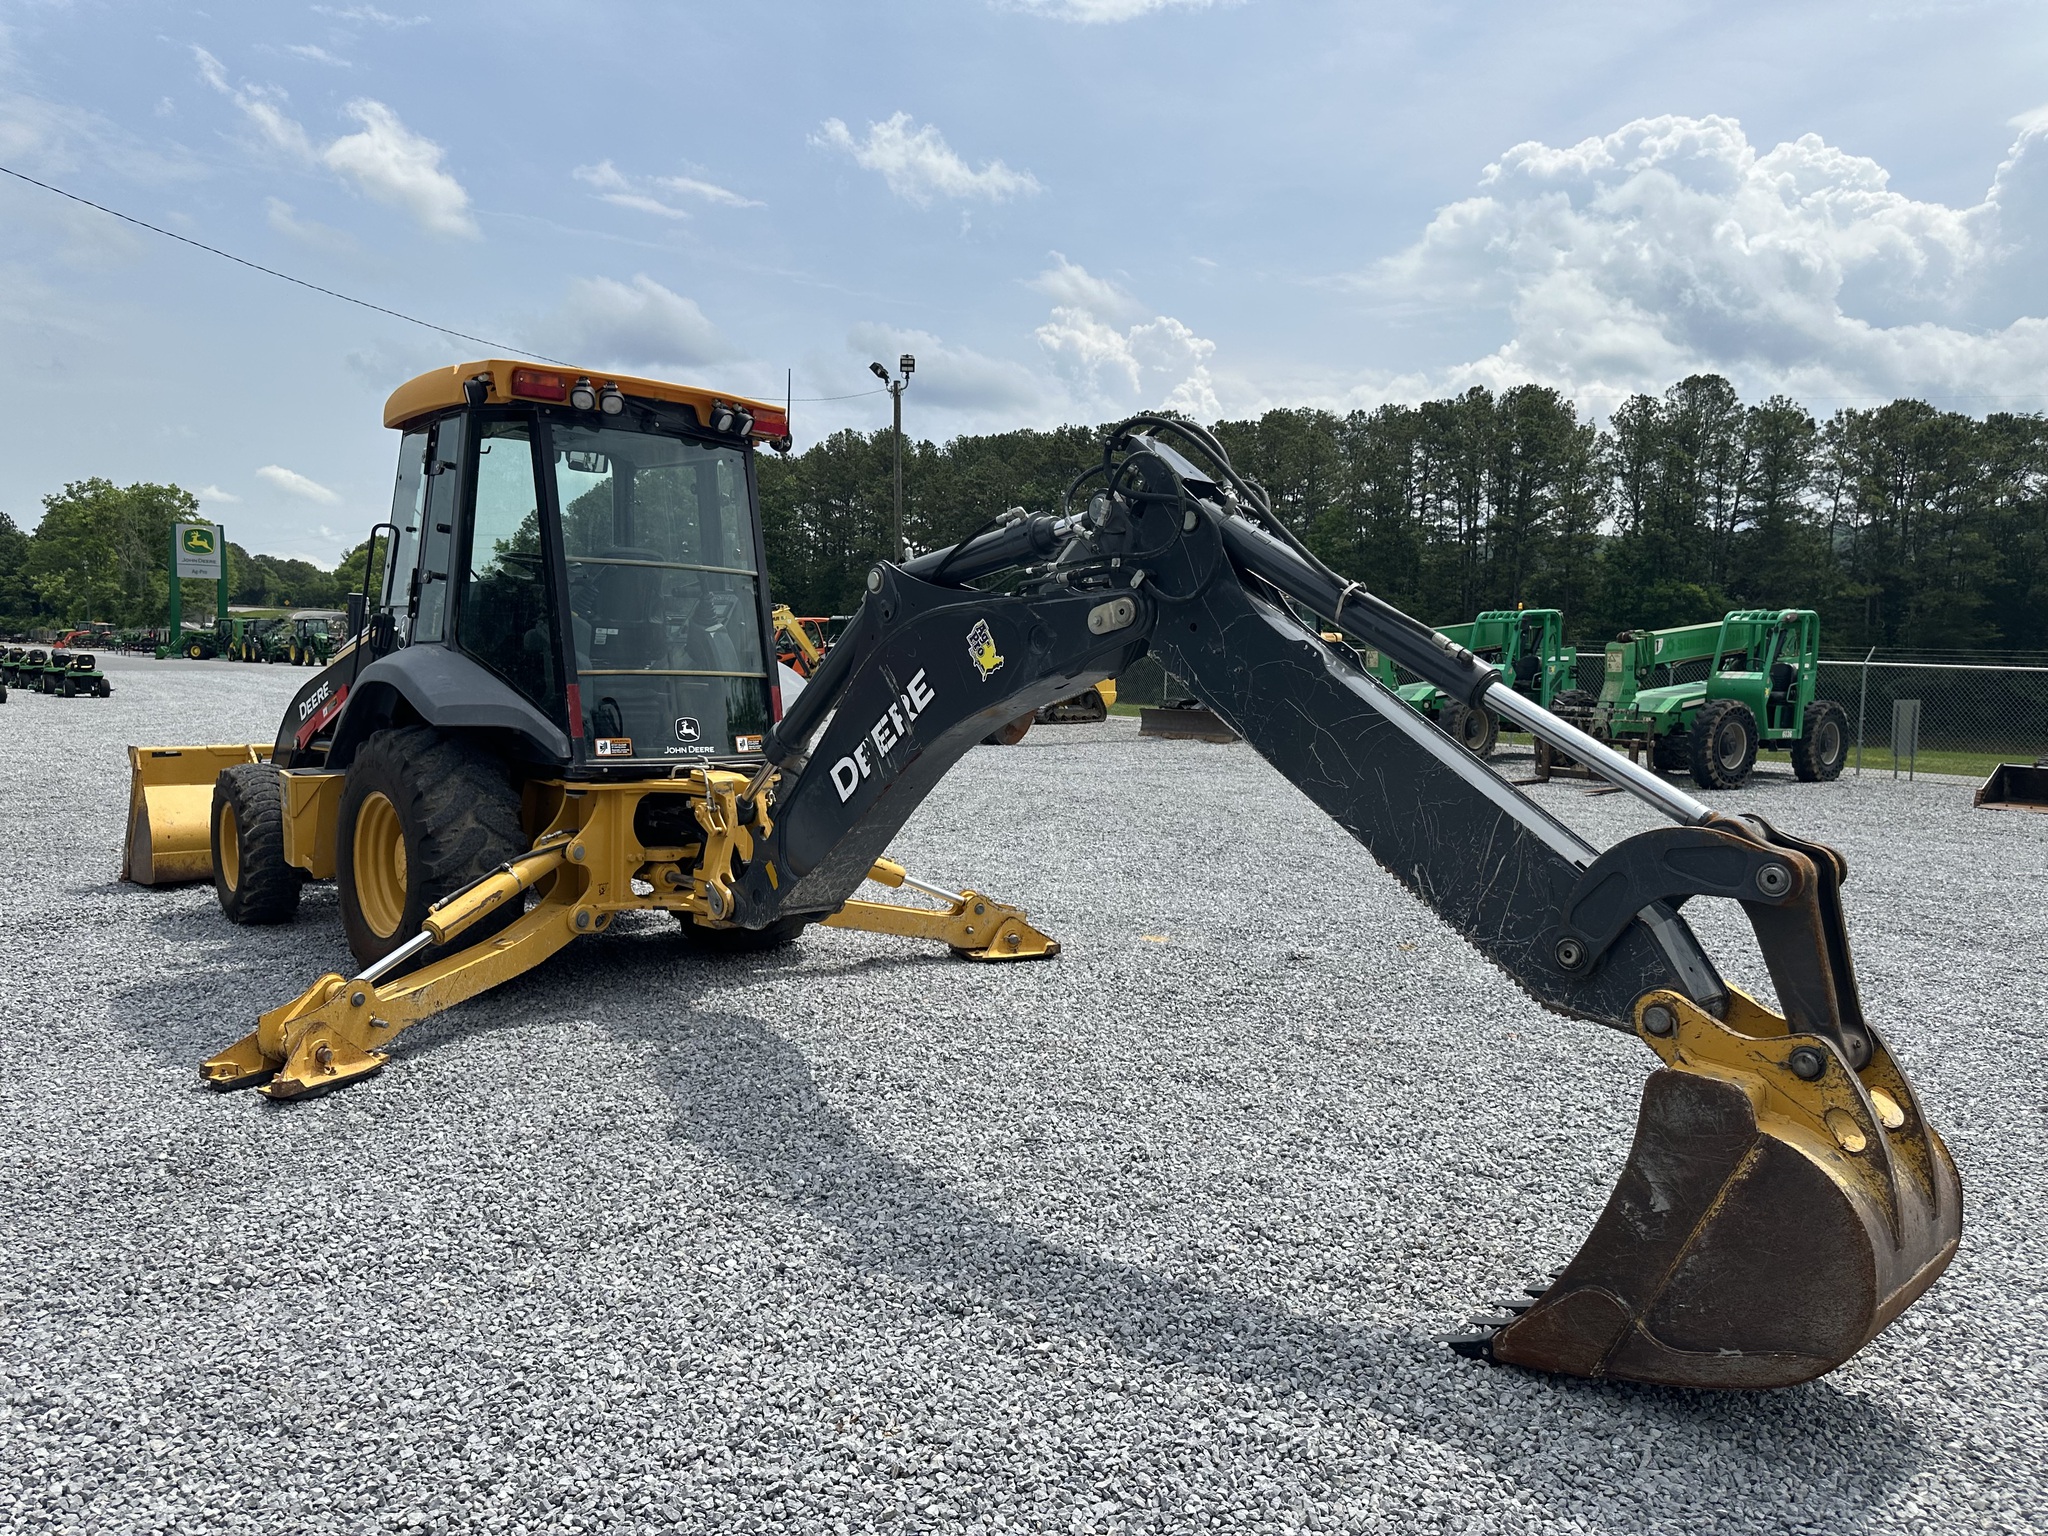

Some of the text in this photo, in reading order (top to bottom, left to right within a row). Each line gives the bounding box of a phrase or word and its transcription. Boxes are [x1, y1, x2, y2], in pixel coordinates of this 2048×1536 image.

[298, 680, 330, 722] DEERE
[664, 745, 715, 755] JOHN DEERE
[829, 667, 936, 804] DEERE
